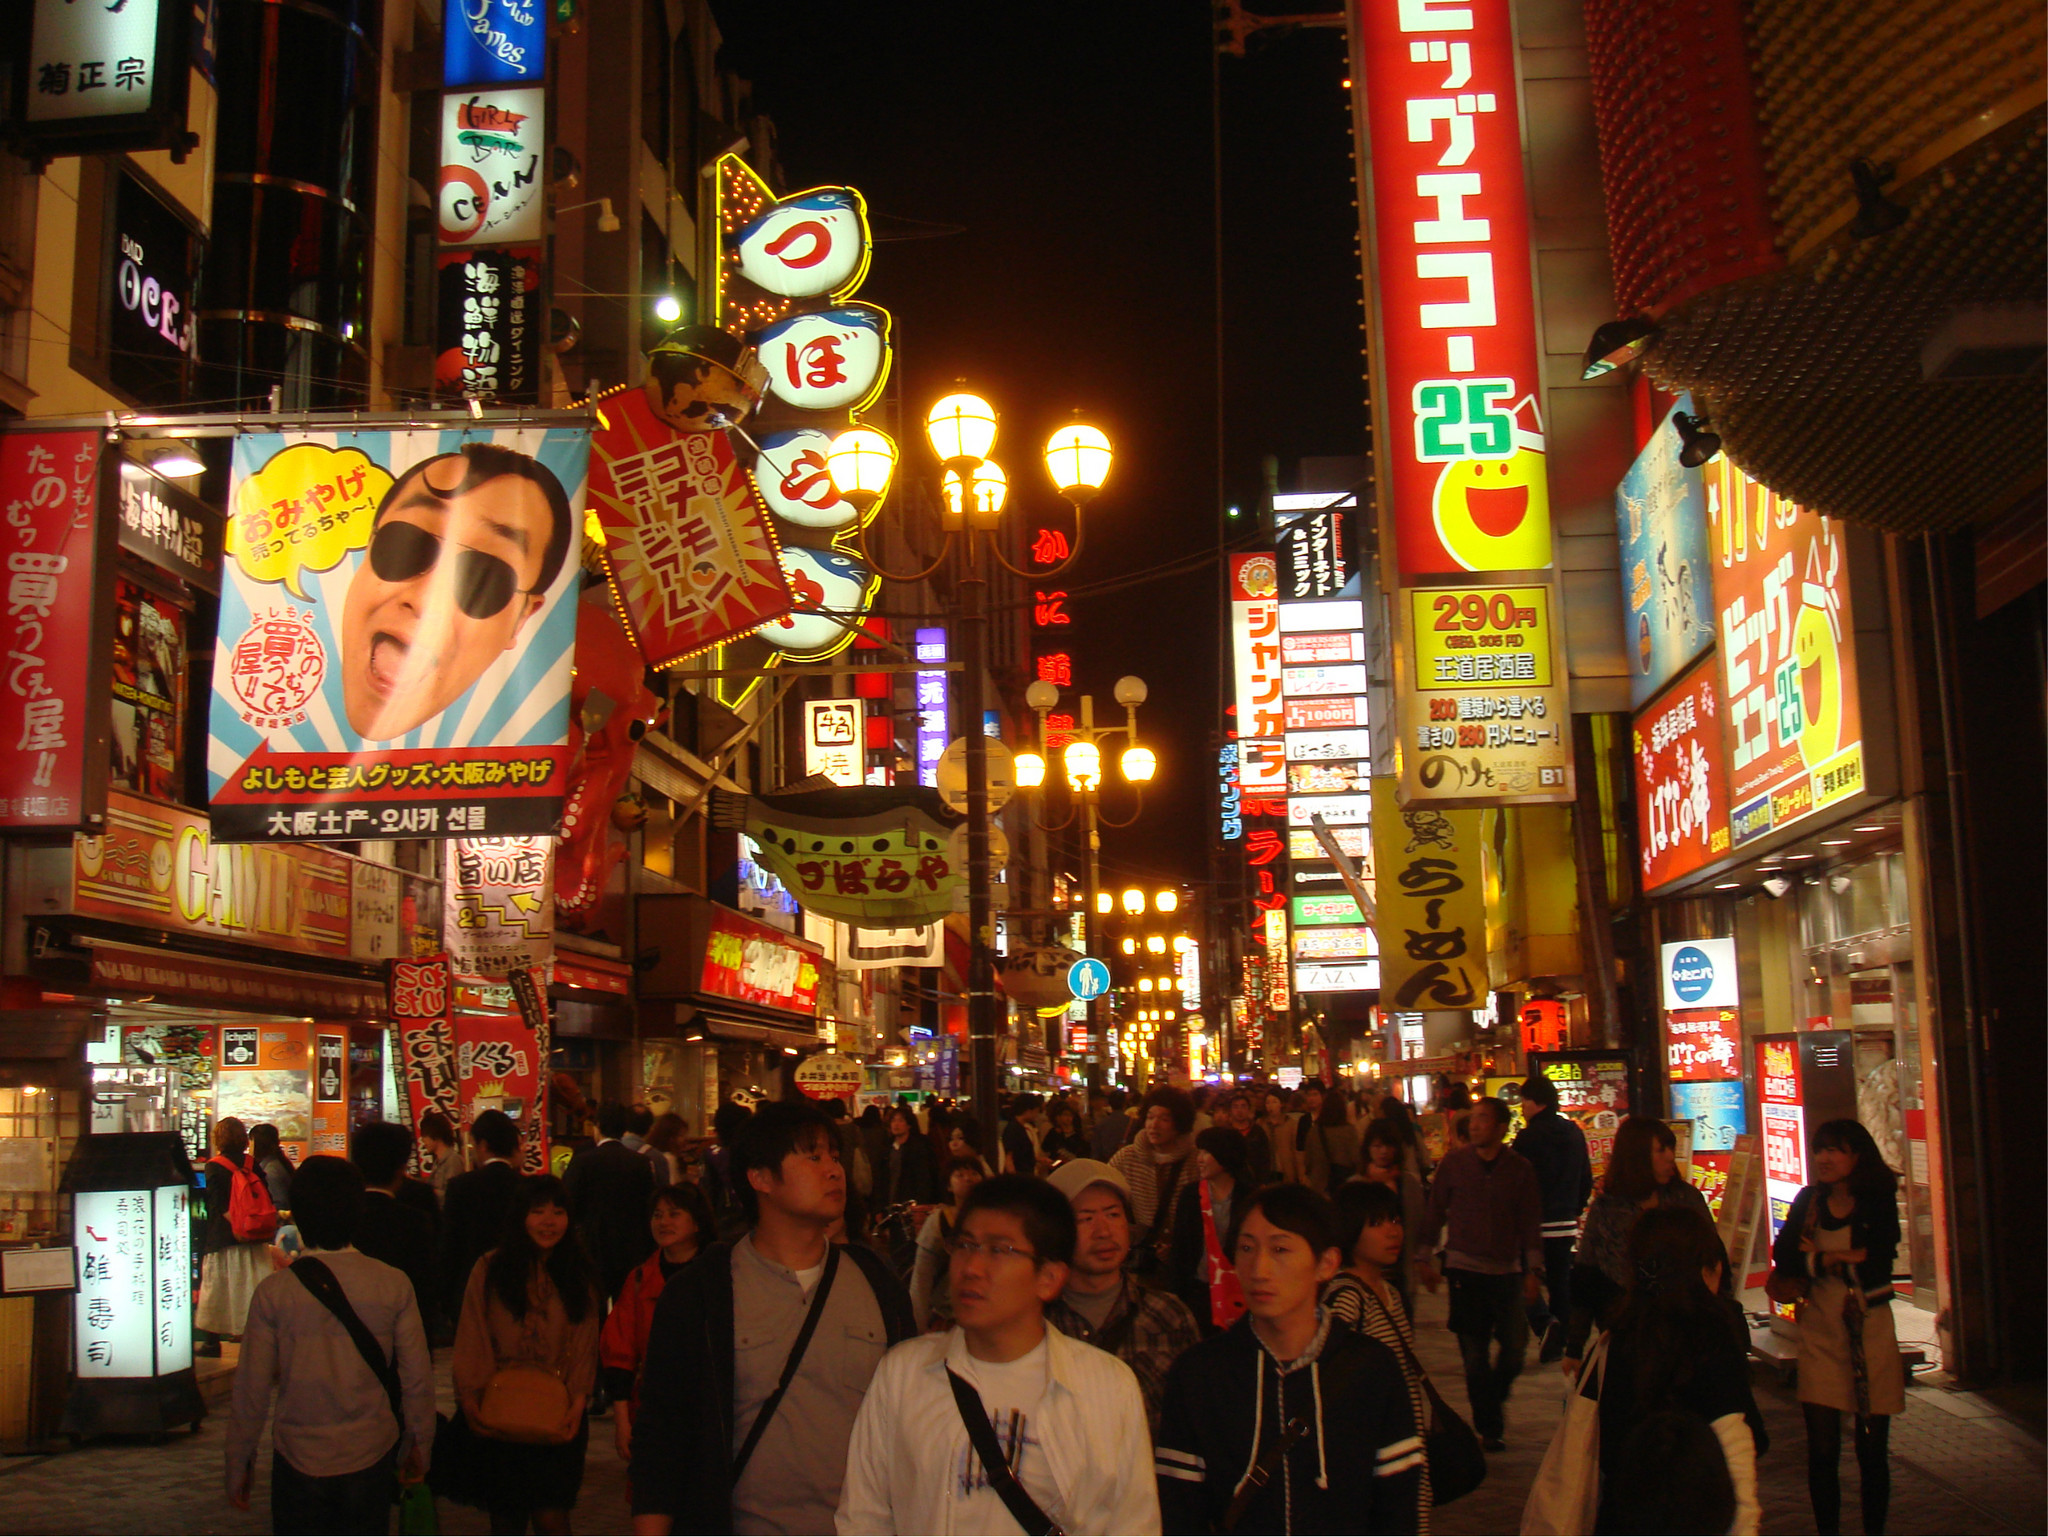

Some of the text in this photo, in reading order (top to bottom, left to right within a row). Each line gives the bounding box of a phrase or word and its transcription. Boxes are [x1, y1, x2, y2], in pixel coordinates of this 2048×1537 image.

[37, 56, 146, 95] 菊正宗
[1418, 384, 1513, 457] 25
[73, 441, 92, 530] よしもと
[240, 464, 368, 544] おみやげ
[611, 456, 702, 623] ミュージアム
[651, 442, 733, 604] コナモン
[1310, 513, 1331, 597] インターネット
[1292, 528, 1312, 598] &コミック
[251, 606, 316, 626] よしもと
[1433, 593, 1537, 631] 290円
[1722, 551, 1795, 699] ビッグ
[1247, 604, 1288, 779] ジャンカラ
[1433, 652, 1536, 682] 王道居酒屋
[819, 712, 851, 737] 牛角
[1429, 698, 1458, 721] 200
[1731, 665, 1800, 771] エコー 25
[1540, 767, 1563, 785] B1
[445, 806, 487, 831] 선물
[457, 850, 543, 887] 旨い店
[799, 854, 950, 896] づぼらや
[1394, 856, 1477, 1009] らーめん
